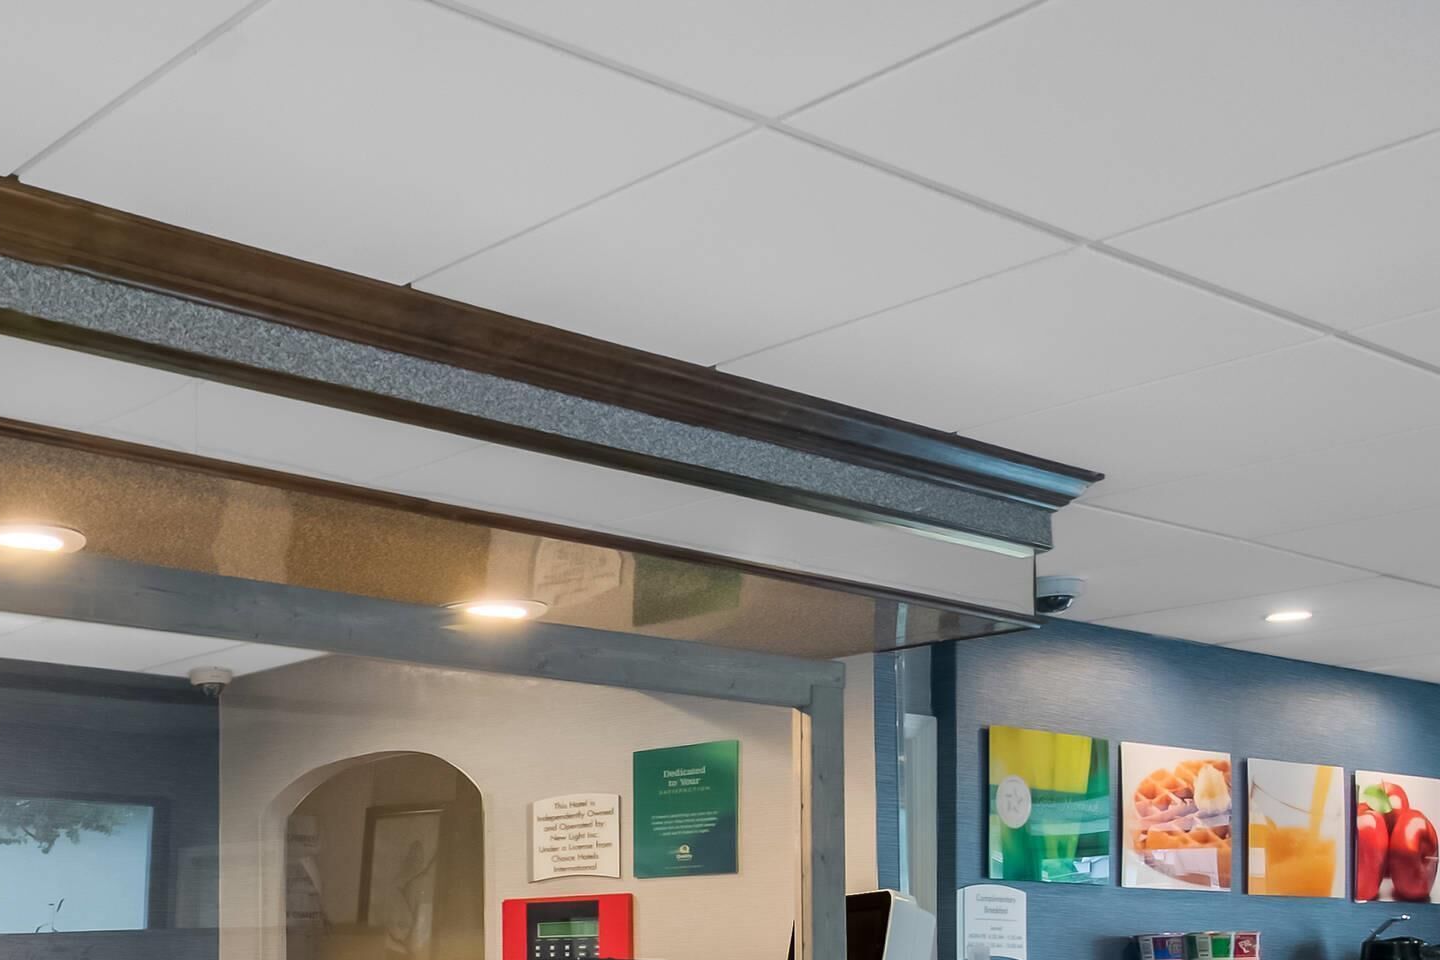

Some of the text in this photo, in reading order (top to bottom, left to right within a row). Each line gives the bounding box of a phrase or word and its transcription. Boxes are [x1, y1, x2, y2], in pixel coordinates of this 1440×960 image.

[663, 766, 706, 778] Dedicated
[680, 778, 701, 786] Your
[569, 800, 587, 808] Hotel
[537, 808, 614, 822] Independently Owned
[544, 824, 558, 832] and
[559, 820, 593, 830] Operated
[568, 832, 585, 841] Light
